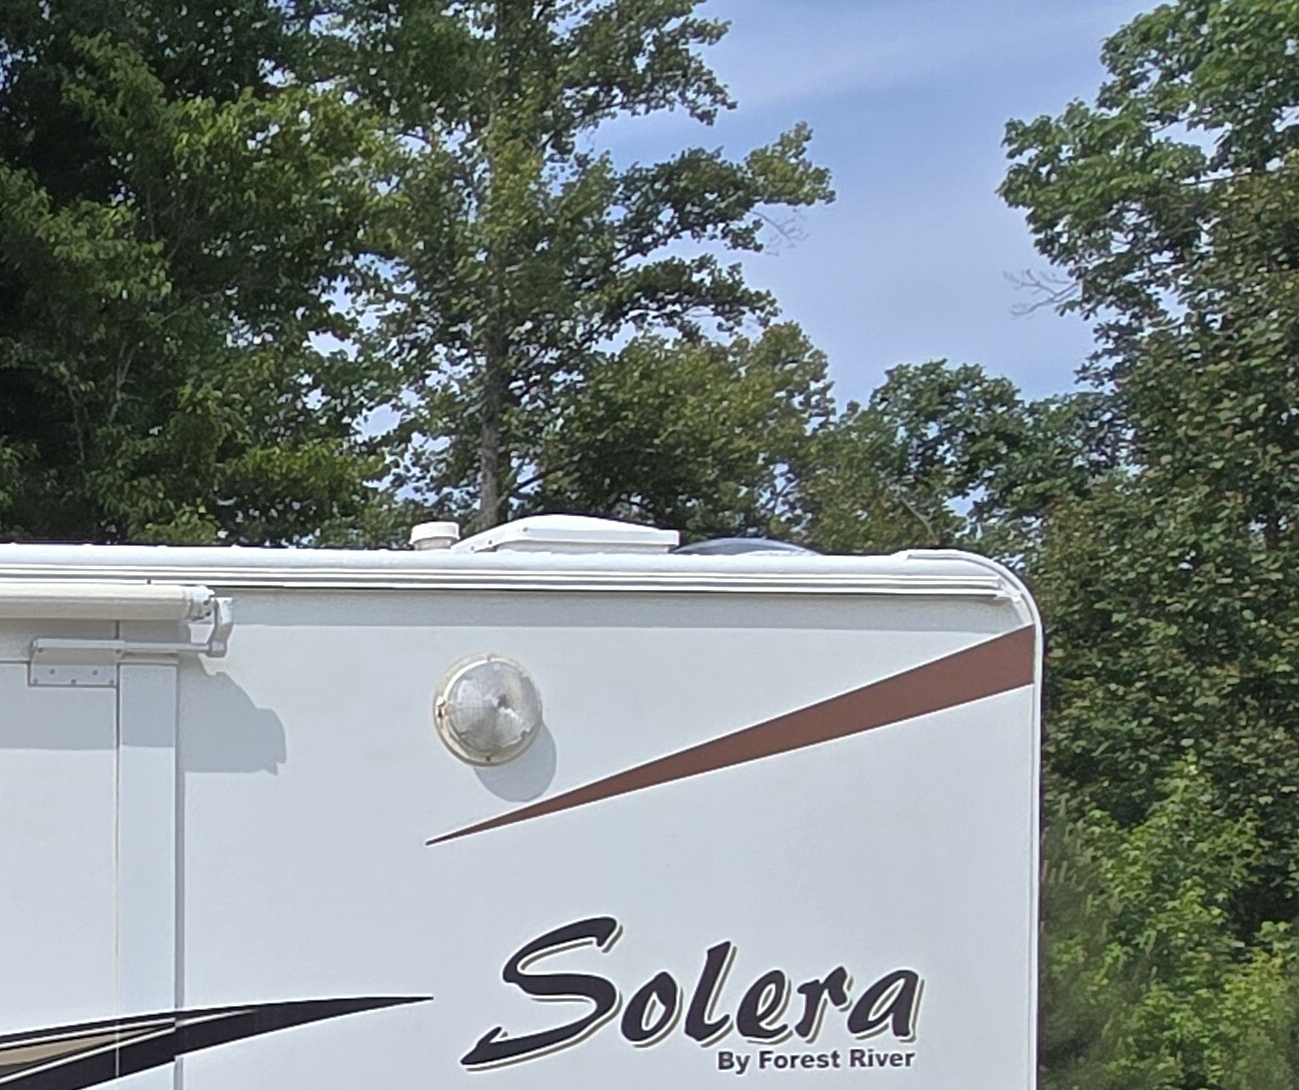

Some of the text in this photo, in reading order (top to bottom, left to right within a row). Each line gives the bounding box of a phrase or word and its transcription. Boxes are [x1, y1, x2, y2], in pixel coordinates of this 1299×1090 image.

[460, 916, 925, 1072] Solera
[717, 1048, 916, 1075] By Forest River
